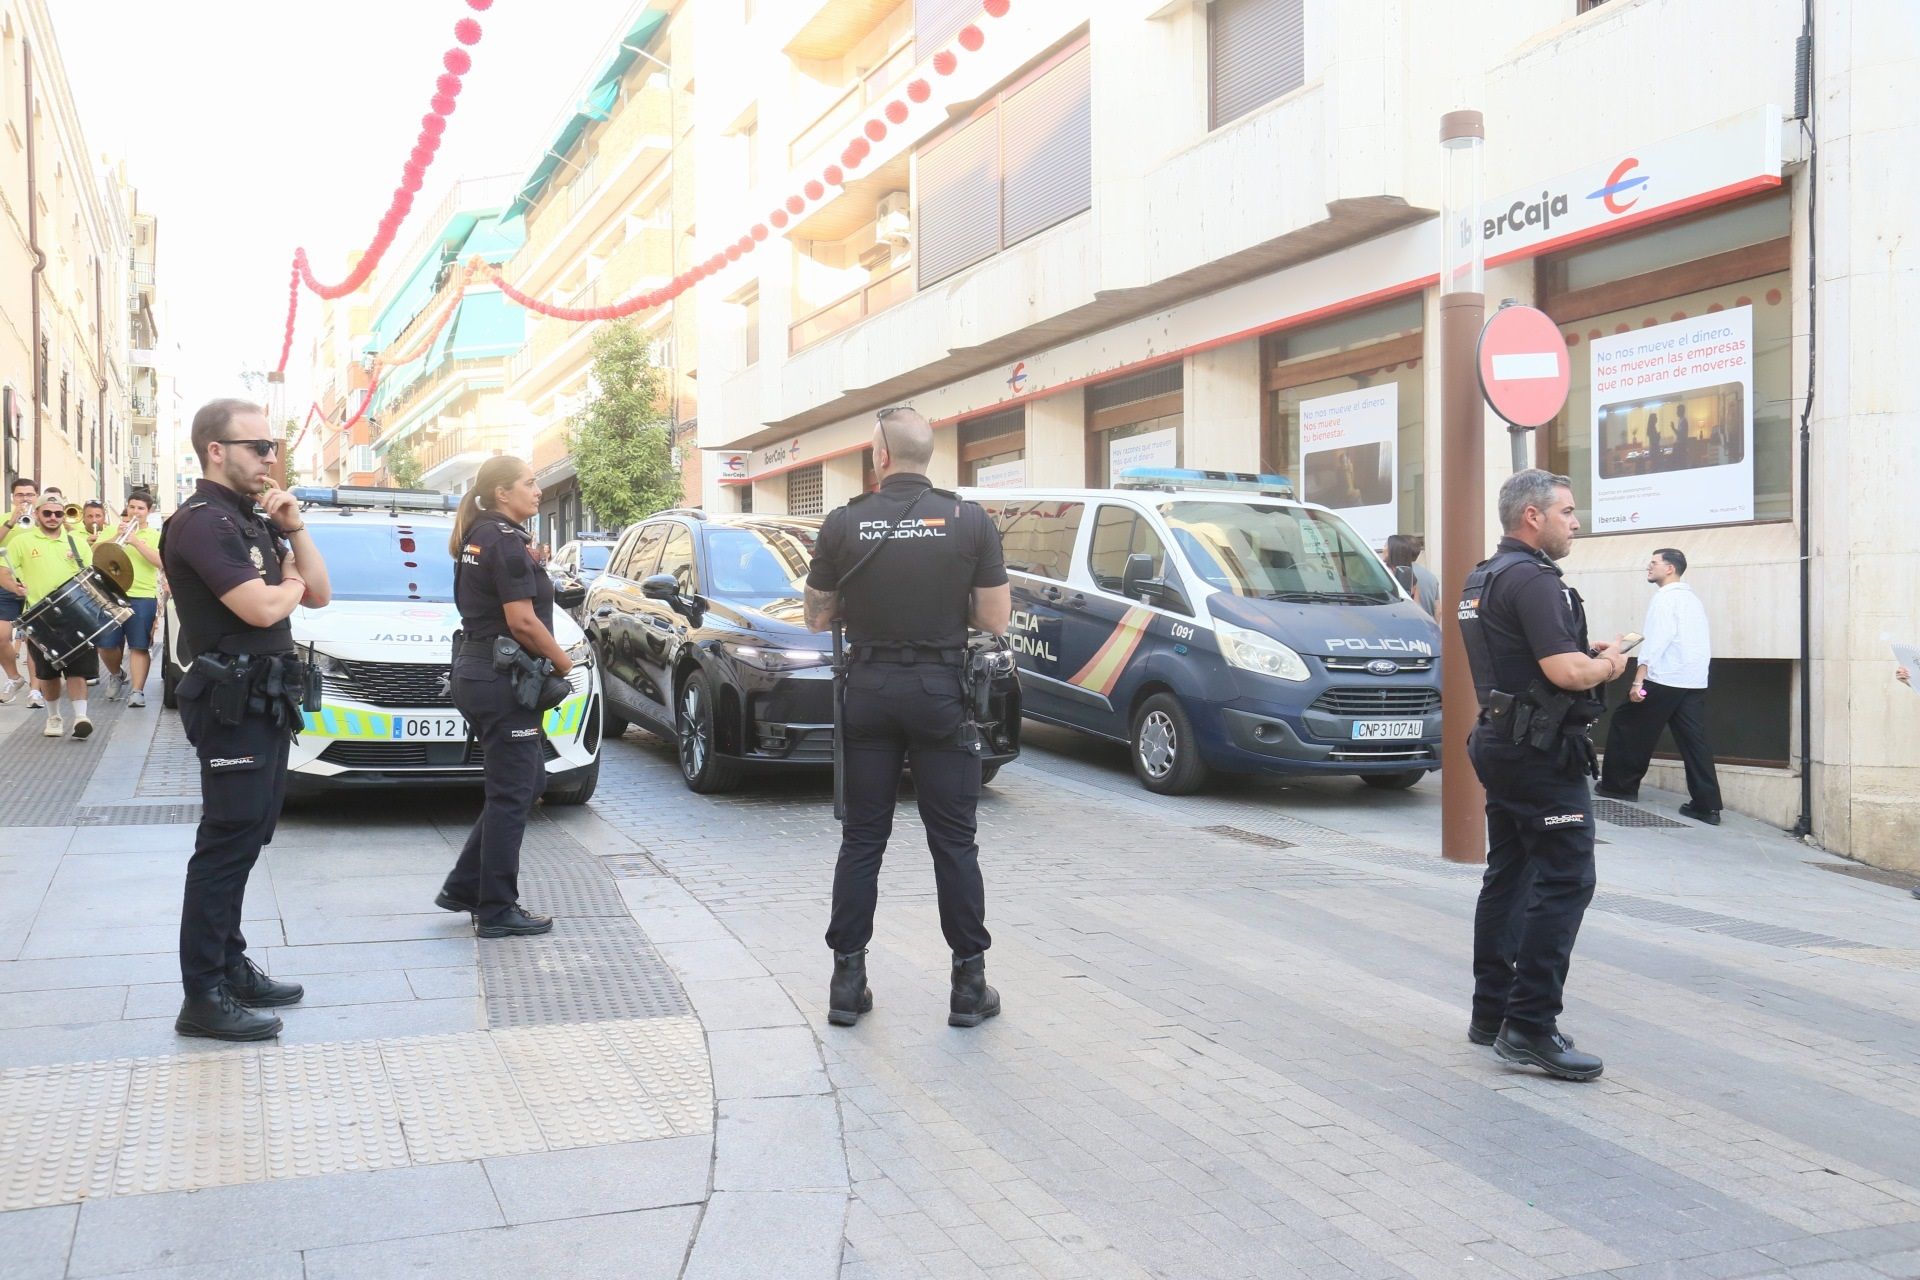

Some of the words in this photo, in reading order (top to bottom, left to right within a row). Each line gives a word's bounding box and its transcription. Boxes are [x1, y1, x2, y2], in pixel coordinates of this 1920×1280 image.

[1460, 190, 1568, 248] iberCaja
[1597, 351, 1612, 363] No
[1615, 348, 1634, 360] nos
[1637, 339, 1675, 354] mueve
[1678, 335, 1688, 346] el
[1692, 327, 1734, 344] dinero.
[1597, 366, 1617, 377] Nos
[1620, 356, 1664, 373] mueven
[1667, 351, 1683, 364] las
[1687, 339, 1746, 361] empresas
[1597, 380, 1617, 393] que
[1620, 376, 1634, 388] no
[1637, 370, 1669, 388] paran
[1673, 366, 1687, 378] de
[1691, 355, 1747, 375] moverse.
[1303, 411, 1313, 420] No
[1315, 409, 1327, 418] nos
[1303, 422, 1316, 431] Nos
[859, 518, 927, 530] POLCIA
[1008, 610, 1039, 633] ICIA
[1176, 624, 1194, 640] 091
[1002, 632, 1058, 662] IONAL
[406, 720, 456, 736] 0612
[1359, 722, 1421, 737] CNP3107AU
